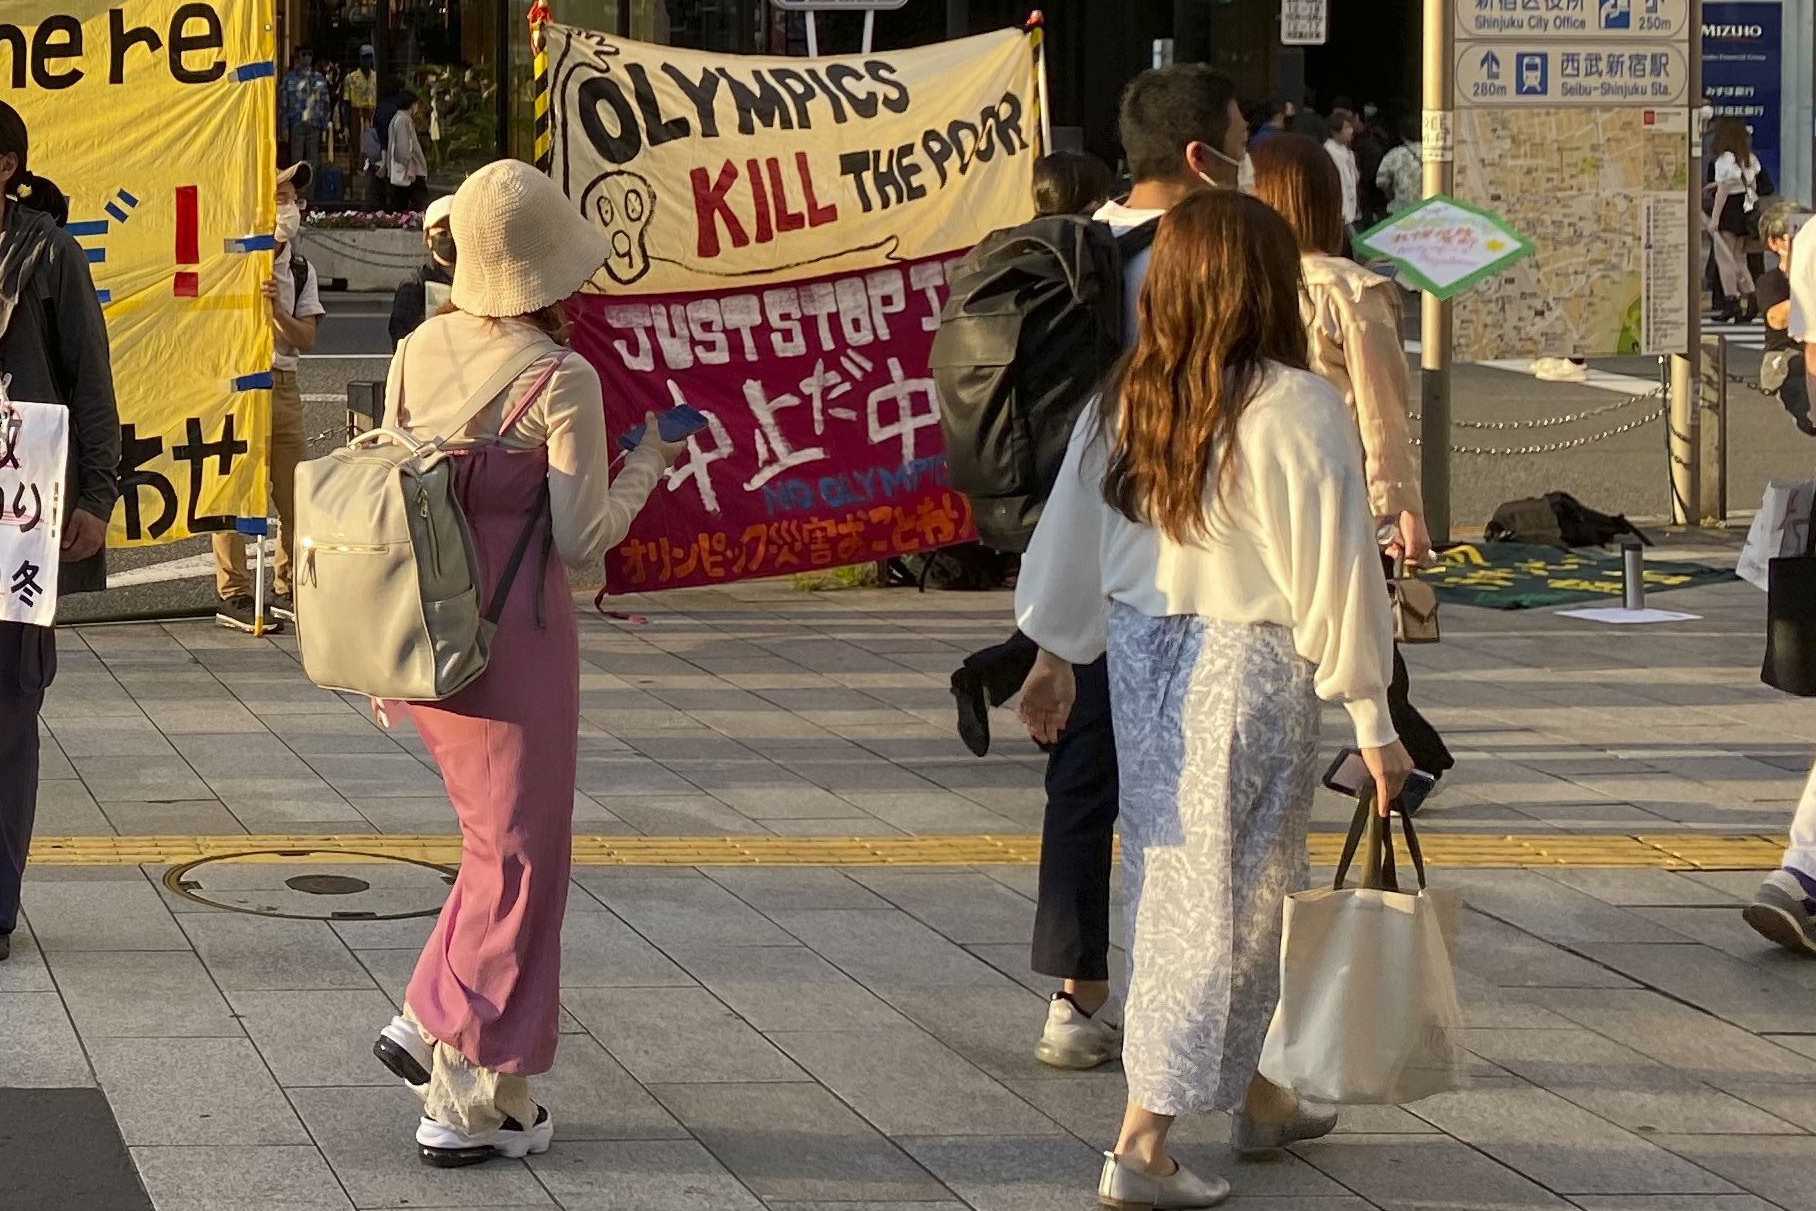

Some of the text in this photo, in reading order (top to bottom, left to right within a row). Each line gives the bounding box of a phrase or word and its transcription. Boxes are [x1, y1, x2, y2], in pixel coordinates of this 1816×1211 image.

[1474, 15, 1586, 33] Shinjuku City Office
[1639, 16, 1672, 31] 250m
[1560, 52, 1670, 79] 西武新宿駅
[581, 60, 910, 164] OLYMPICS
[689, 151, 839, 258] KILL
[839, 140, 927, 214] THE
[605, 296, 762, 373] JUST
[763, 274, 907, 358] STOP
[10, 559, 44, 608] 冬
